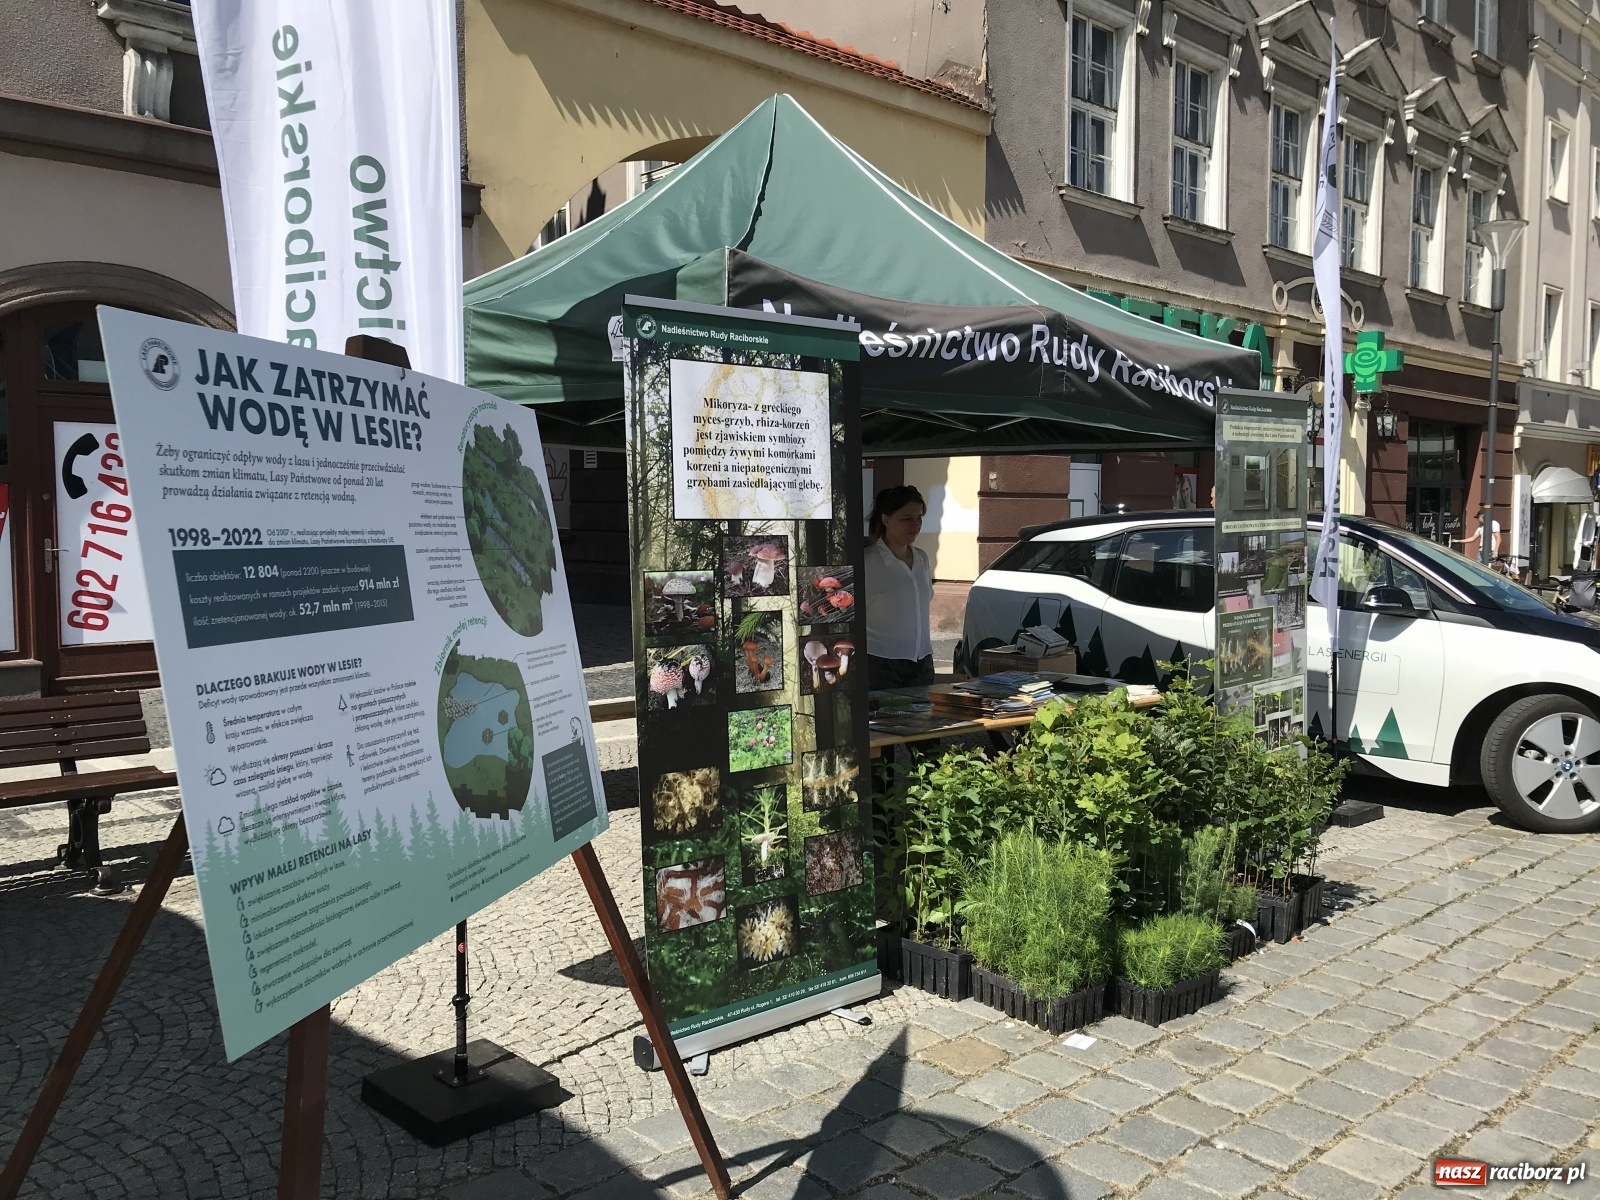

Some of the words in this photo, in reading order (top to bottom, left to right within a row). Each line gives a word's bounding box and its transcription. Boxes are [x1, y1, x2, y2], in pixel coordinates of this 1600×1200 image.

[662, 324, 709, 338] Nadleśnictwo
[710, 330, 728, 342] Rudy
[730, 332, 768, 344] Raciborskie
[1030, 323, 1106, 385] Rudy
[1110, 349, 1233, 407] Racibors
[194, 348, 264, 393] JAK
[270, 361, 430, 420] ZATRZYMAĆ
[704, 398, 752, 412] Mikoryza-
[754, 403, 759, 411] z
[761, 402, 802, 416] greckiego
[197, 392, 308, 448] WODĘ
[312, 408, 342, 442] W
[351, 413, 422, 452] LESIE?
[693, 415, 754, 428] myces-grzyb,
[756, 418, 810, 430] rhiza-korzeń
[696, 429, 712, 442] jest
[715, 430, 766, 443] zjawiskiem
[768, 433, 806, 447] symbiozy
[156, 442, 180, 460] Żeby
[182, 449, 231, 464] ograniczyć
[232, 450, 263, 466] odpływ
[265, 454, 287, 468] wody
[295, 455, 310, 466] lasu
[316, 458, 360, 470] jednocześnie
[684, 446, 727, 459] pomiędzy
[730, 447, 765, 459] żywymi
[768, 448, 816, 460] komórkami
[159, 464, 200, 478] skutkom
[202, 468, 230, 479] zmian
[232, 468, 268, 482] klimatu,
[270, 471, 288, 485] Lasy
[290, 472, 331, 484] Państwowe
[333, 475, 341, 485] od
[343, 476, 365, 488] ponad
[366, 477, 374, 487] 20
[375, 477, 384, 487] lat
[686, 460, 721, 472] korzeni
[732, 462, 812, 476] niepatogenicznymi
[162, 485, 210, 500] prowadzą
[211, 485, 253, 498] działania
[255, 489, 292, 502] związane
[300, 491, 330, 504] retencją
[331, 491, 357, 504] wodną.
[686, 477, 730, 490] grzybami
[732, 478, 797, 491] zasiedlającymi
[798, 480, 823, 492] glebę.
[81, 500, 132, 560] 716
[185, 571, 208, 582] liczba
[210, 570, 242, 580] obiektów:
[242, 566, 256, 579] 12
[258, 564, 279, 578] 804
[280, 567, 302, 579] (ponad
[303, 566, 320, 576] 2200
[320, 566, 340, 576] jeszcze
[346, 564, 371, 574] budowie)
[67, 569, 118, 631] 602
[188, 594, 212, 605] koszty
[213, 590, 261, 602] realizowanych
[268, 588, 292, 598] ramach
[292, 586, 320, 598] projektów
[342, 582, 359, 594] ponad
[358, 578, 375, 590] 914
[376, 576, 391, 590] mln
[392, 576, 400, 588] zł
[192, 616, 210, 626] ilość
[210, 611, 268, 624] zretencjonowanej
[268, 608, 288, 620] wody:
[288, 606, 298, 618] ok.
[300, 601, 320, 616] 52,7
[322, 600, 340, 613] mln
[434, 635, 453, 676] Zbiornik
[452, 618, 468, 638] małej
[468, 616, 487, 628] retencji
[1308, 646, 1332, 658] LAS
[1338, 648, 1386, 662] ENERGII
[196, 676, 252, 696] DLACZEGO
[254, 669, 296, 686] BRAKUJE
[297, 664, 326, 678] WODY
[327, 662, 336, 672] W
[338, 658, 362, 671] LESIE?
[198, 698, 220, 710] Deficyt
[220, 695, 238, 706] wody
[238, 688, 278, 702] spowodowany
[279, 686, 288, 695] jest
[288, 682, 307, 694] przede
[308, 678, 331, 690] wszystkim
[332, 675, 354, 684] zmianami
[223, 716, 246, 727] Średnia
[247, 710, 280, 722] temperatura
[287, 704, 302, 714] całym
[230, 872, 264, 895] WPYW
[267, 859, 297, 880] MAŁEJ
[298, 843, 337, 867] RETENCJI
[338, 838, 352, 851] NA
[353, 829, 372, 846] LASY
